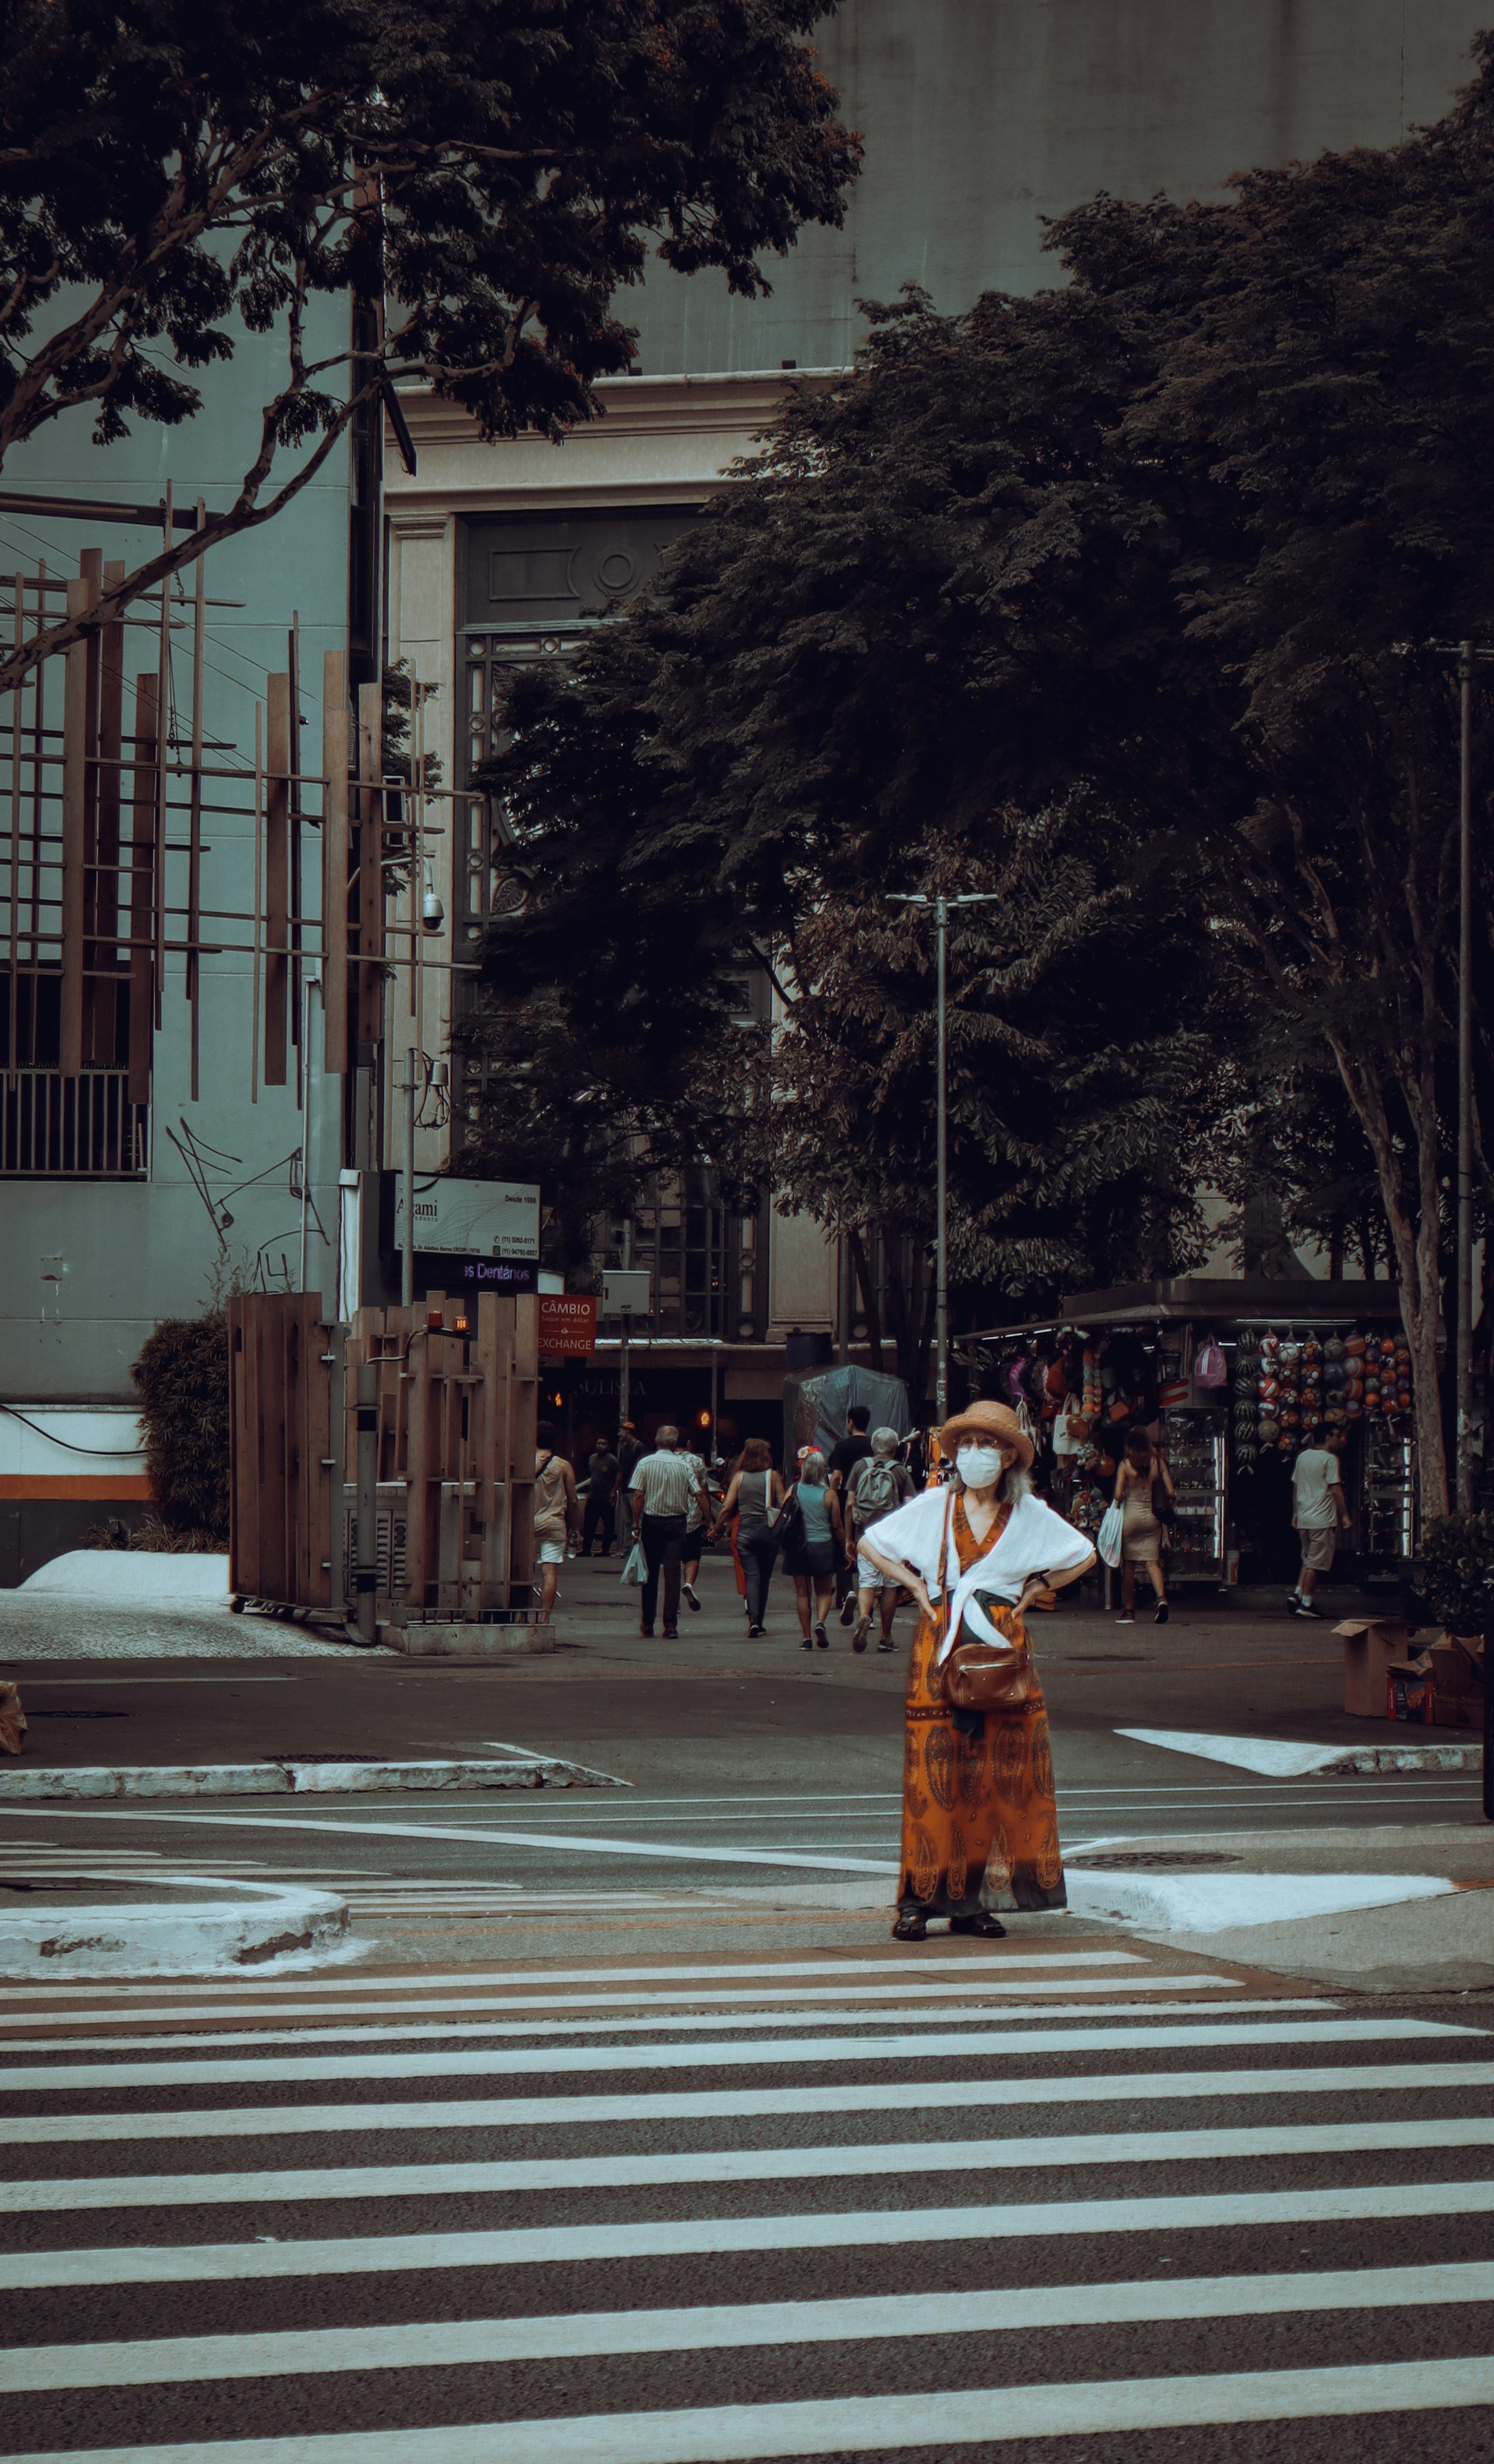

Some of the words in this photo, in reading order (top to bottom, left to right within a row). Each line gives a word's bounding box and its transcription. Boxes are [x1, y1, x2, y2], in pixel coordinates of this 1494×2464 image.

[505, 1195, 522, 1203] Desde
[397, 1197, 437, 1218] Aami
[502, 1235, 511, 1244] (11)
[541, 1300, 590, 1315] CÂMBIO
[539, 1338, 591, 1350] EXCHANGE
